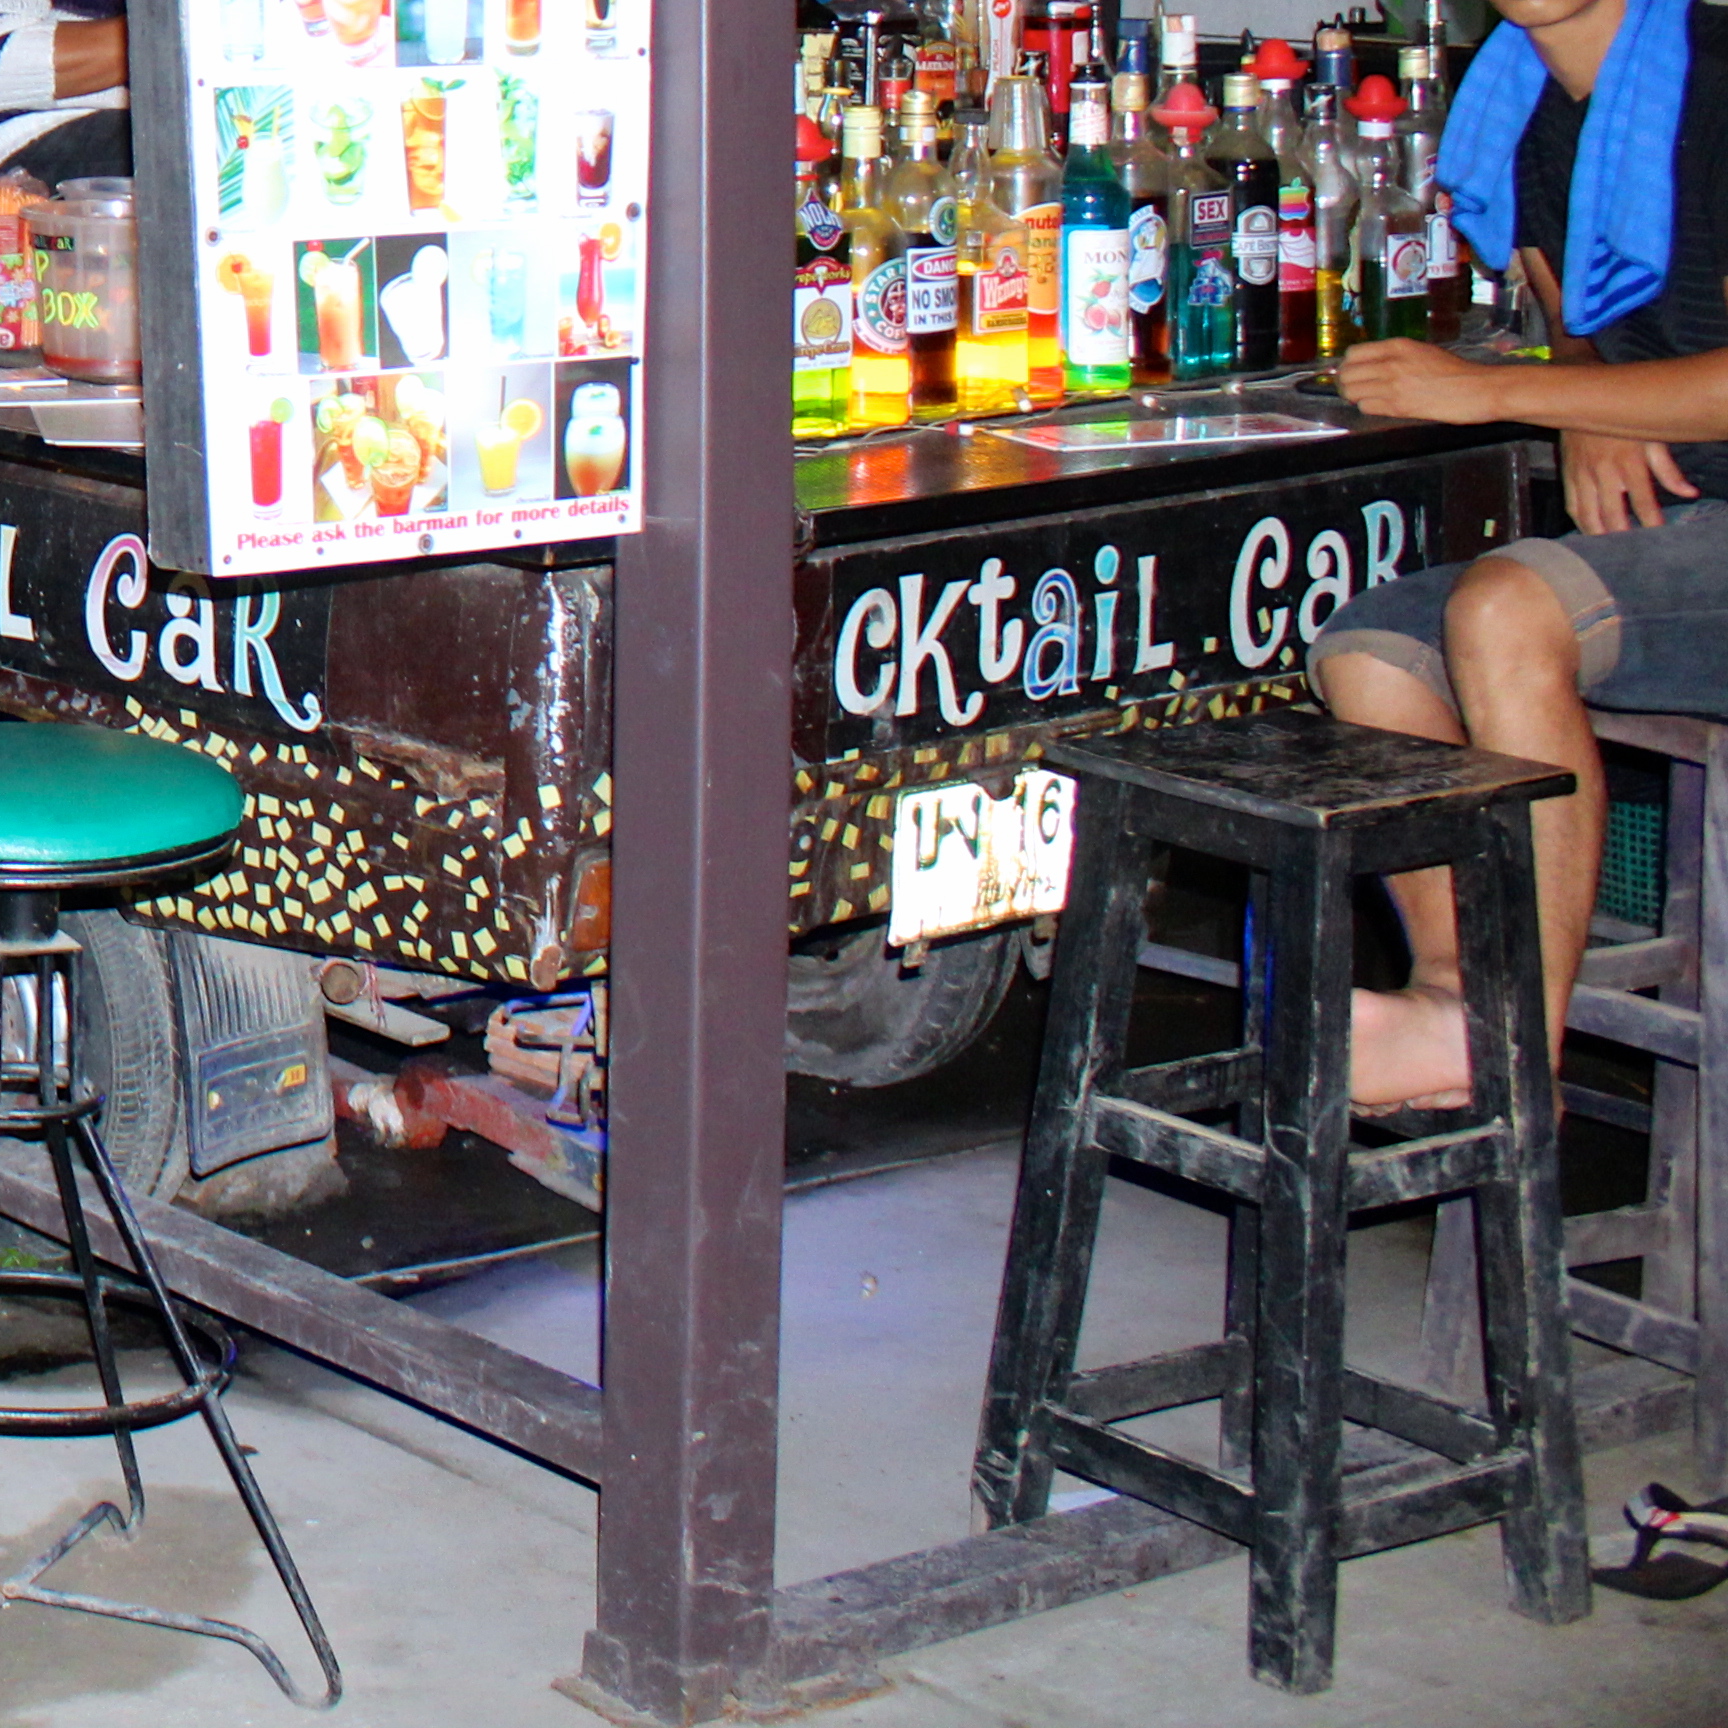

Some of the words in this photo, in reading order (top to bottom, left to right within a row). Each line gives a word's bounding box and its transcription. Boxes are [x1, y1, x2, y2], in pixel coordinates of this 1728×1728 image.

[1197, 200, 1226, 221] SEX
[923, 254, 957, 272] DANG
[1084, 248, 1128, 264] MON
[911, 289, 930, 308] NO
[930, 312, 953, 326] THIS
[237, 530, 304, 550] Please
[311, 526, 346, 543] ask
[354, 521, 385, 539] the
[392, 512, 469, 536] barman
[475, 509, 503, 528] for
[510, 504, 561, 524] more
[567, 495, 631, 519] details
